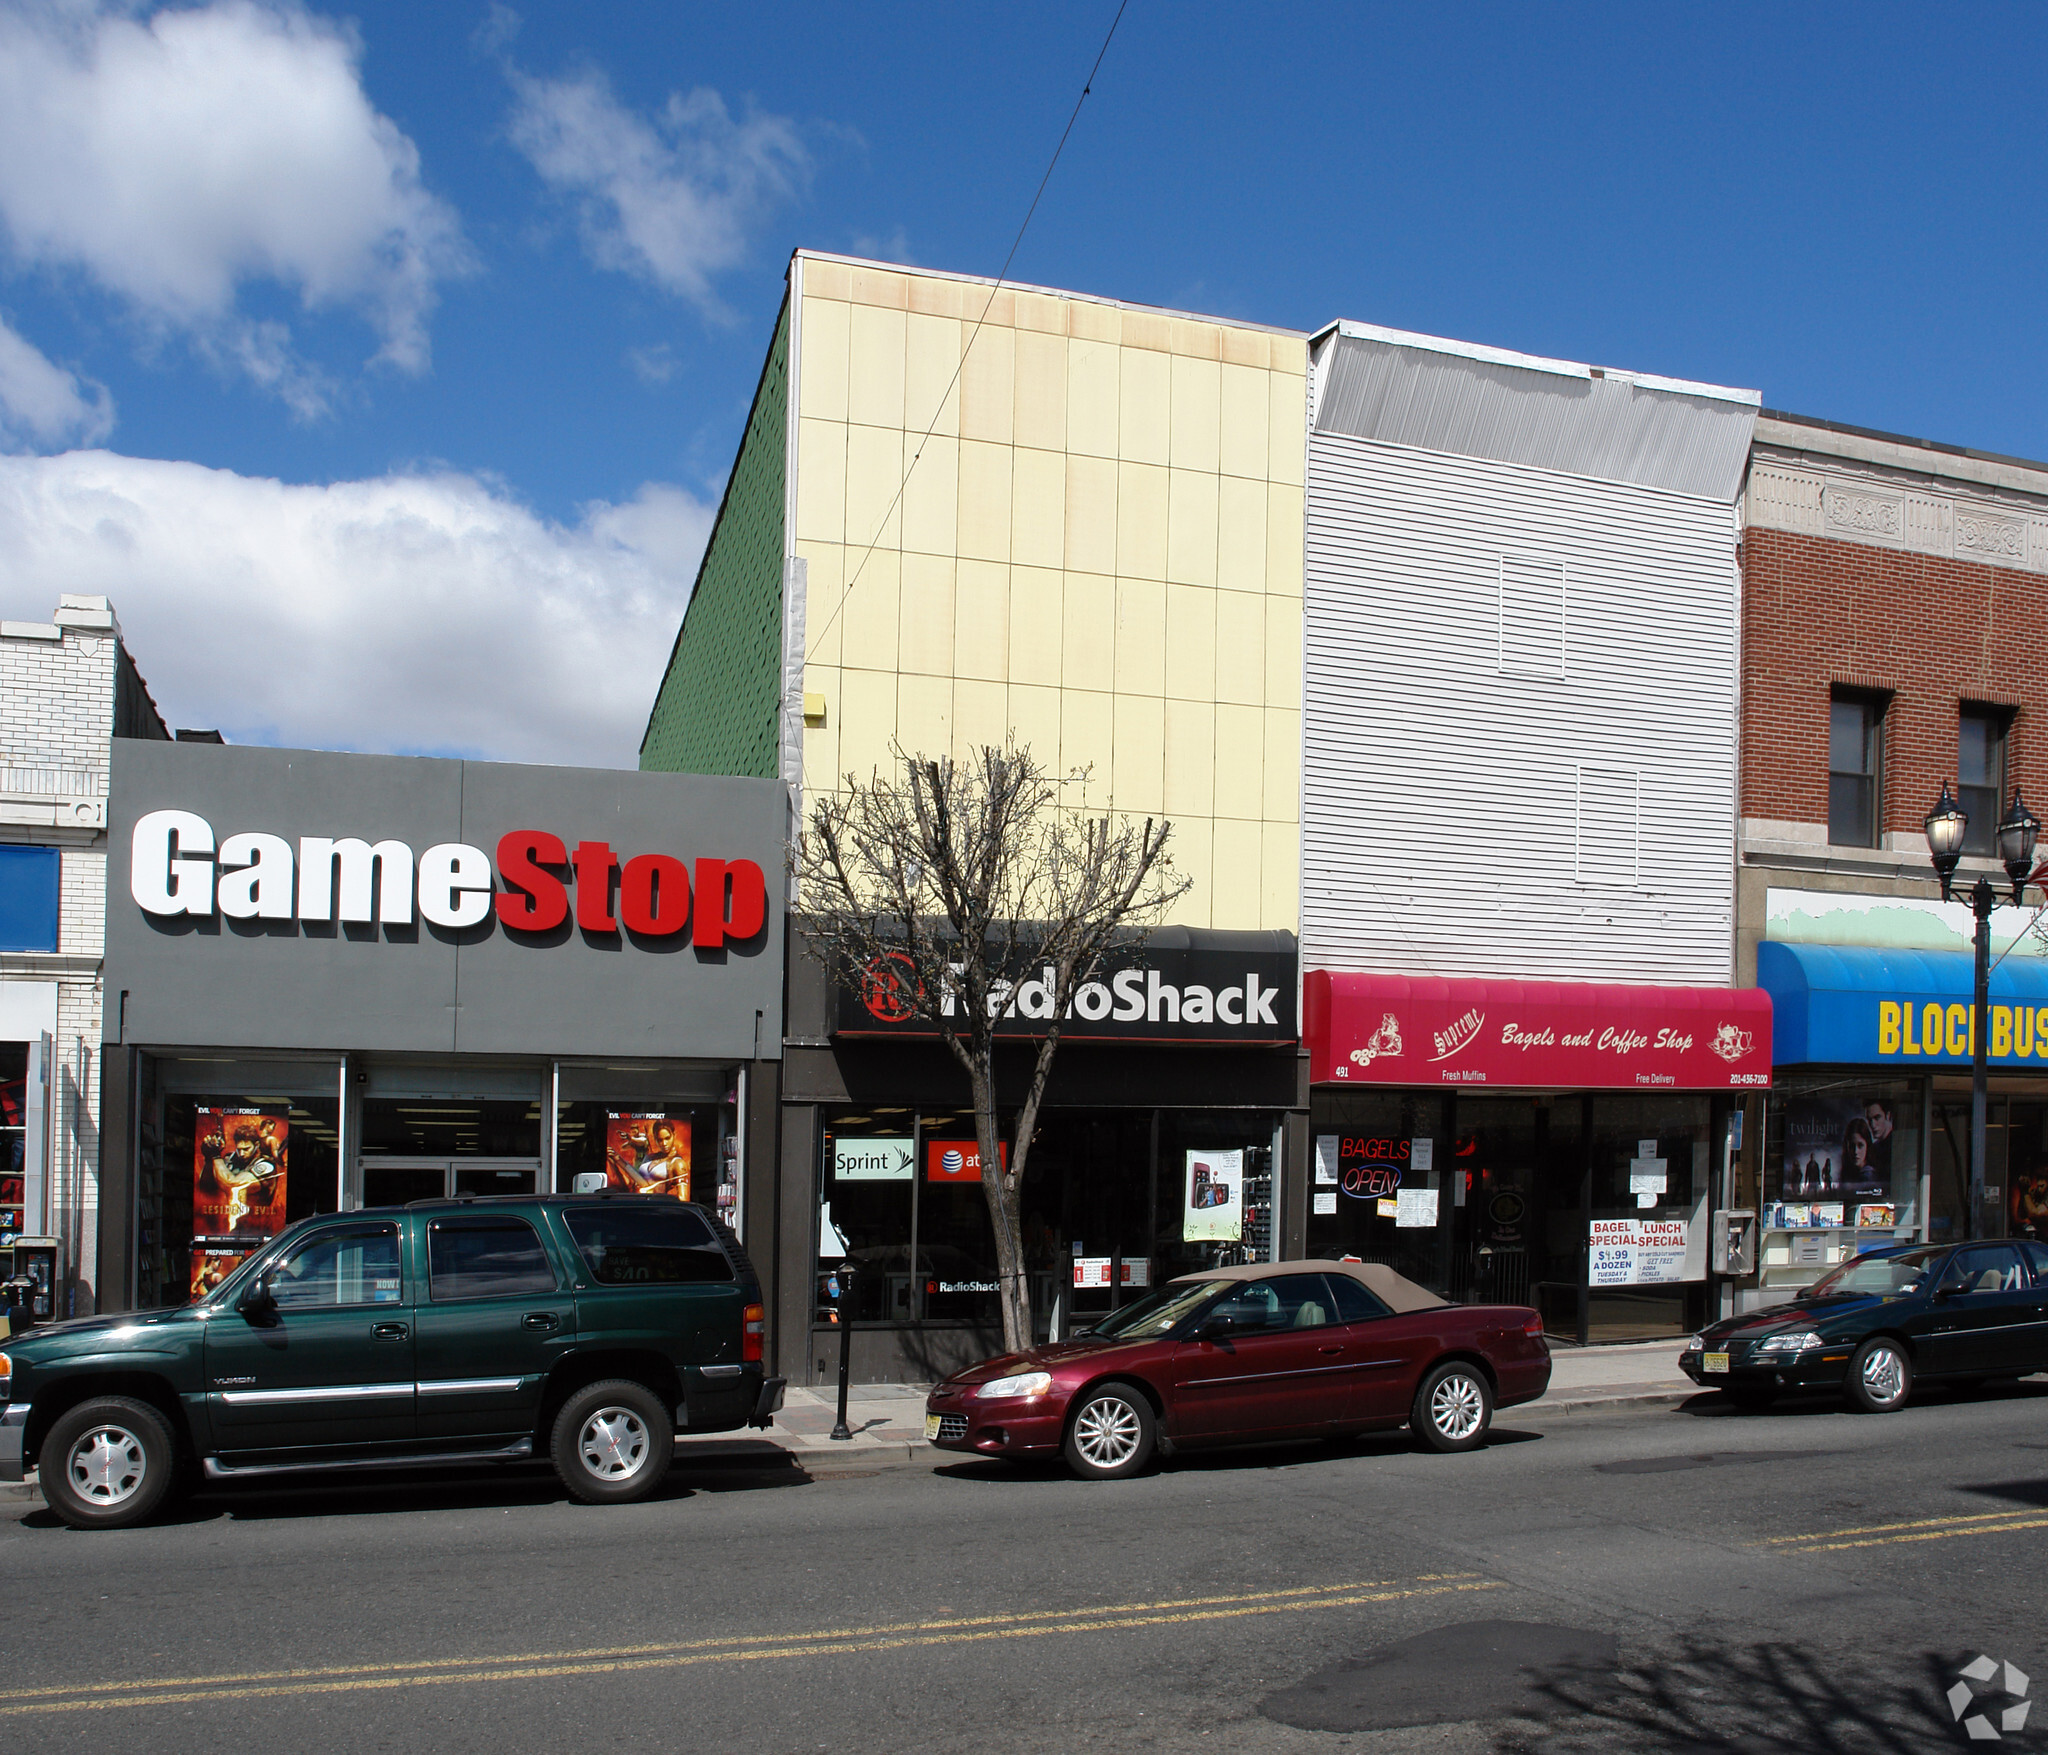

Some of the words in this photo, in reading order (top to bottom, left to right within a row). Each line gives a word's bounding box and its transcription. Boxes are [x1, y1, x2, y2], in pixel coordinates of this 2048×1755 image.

[131, 810, 766, 948] GameStop
[940, 962, 1280, 1025] RadoShack
[1433, 1008, 1480, 1056] Supreme
[1501, 1023, 1555, 1051] Bagels
[1561, 1028, 1594, 1047] and
[1597, 1026, 1648, 1054] Coffee
[1653, 1027, 1693, 1054] Shop
[1335, 1066, 1349, 1078] 491
[1442, 1070, 1461, 1081] Fresh
[1462, 1070, 1486, 1081] Muffins
[1636, 1073, 1650, 1084] Free
[1651, 1073, 1675, 1087] Delivery
[1790, 1115, 1840, 1136] twilight
[1341, 1138, 1410, 1160] BAGELS
[836, 1153, 888, 1175] Sprint
[1344, 1168, 1398, 1193] OPEN
[203, 1205, 250, 1215] RESIDENT
[254, 1206, 276, 1215] EVIL
[1594, 1222, 1631, 1233] BAGEL
[1644, 1223, 1682, 1234] LUNCH
[1589, 1235, 1637, 1246] SPECIAL
[1638, 1236, 1686, 1247] SPECIAL
[1598, 1250, 1628, 1260] $4.99
[1601, 1261, 1632, 1269] DOZEN
[940, 1281, 1000, 1292] RadioShack
[213, 1376, 256, 1384] YUKON
